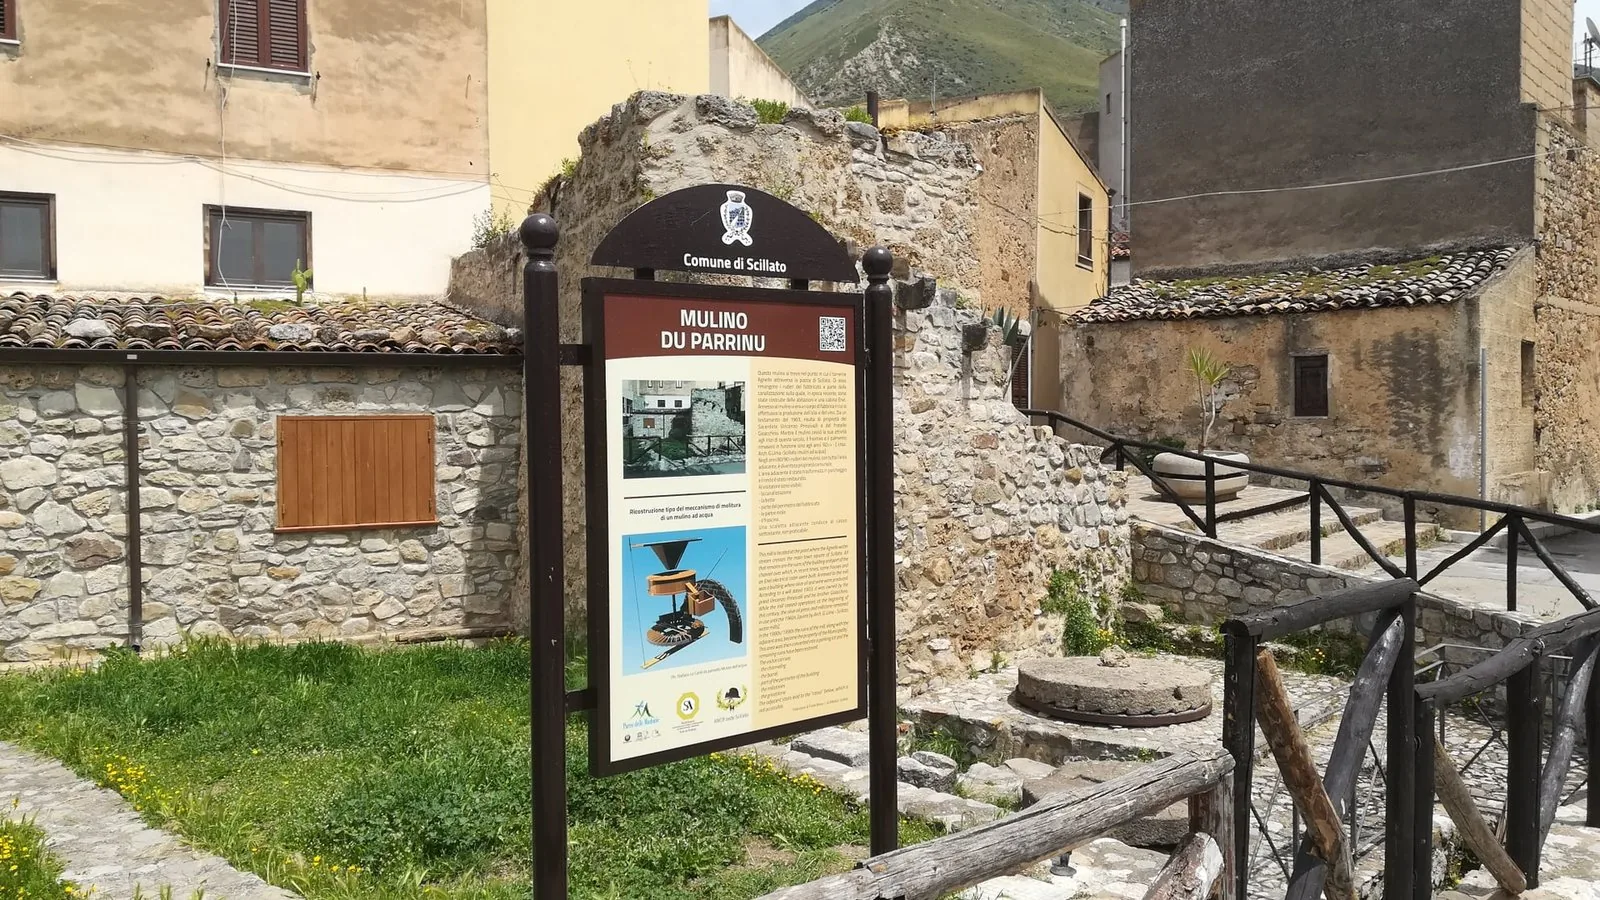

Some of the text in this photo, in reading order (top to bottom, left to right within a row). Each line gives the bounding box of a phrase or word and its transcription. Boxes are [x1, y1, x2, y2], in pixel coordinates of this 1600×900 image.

[684, 253, 786, 273] Comune di Scillato
[680, 310, 748, 329] MULINO
[661, 331, 765, 351] DU PARRINU
